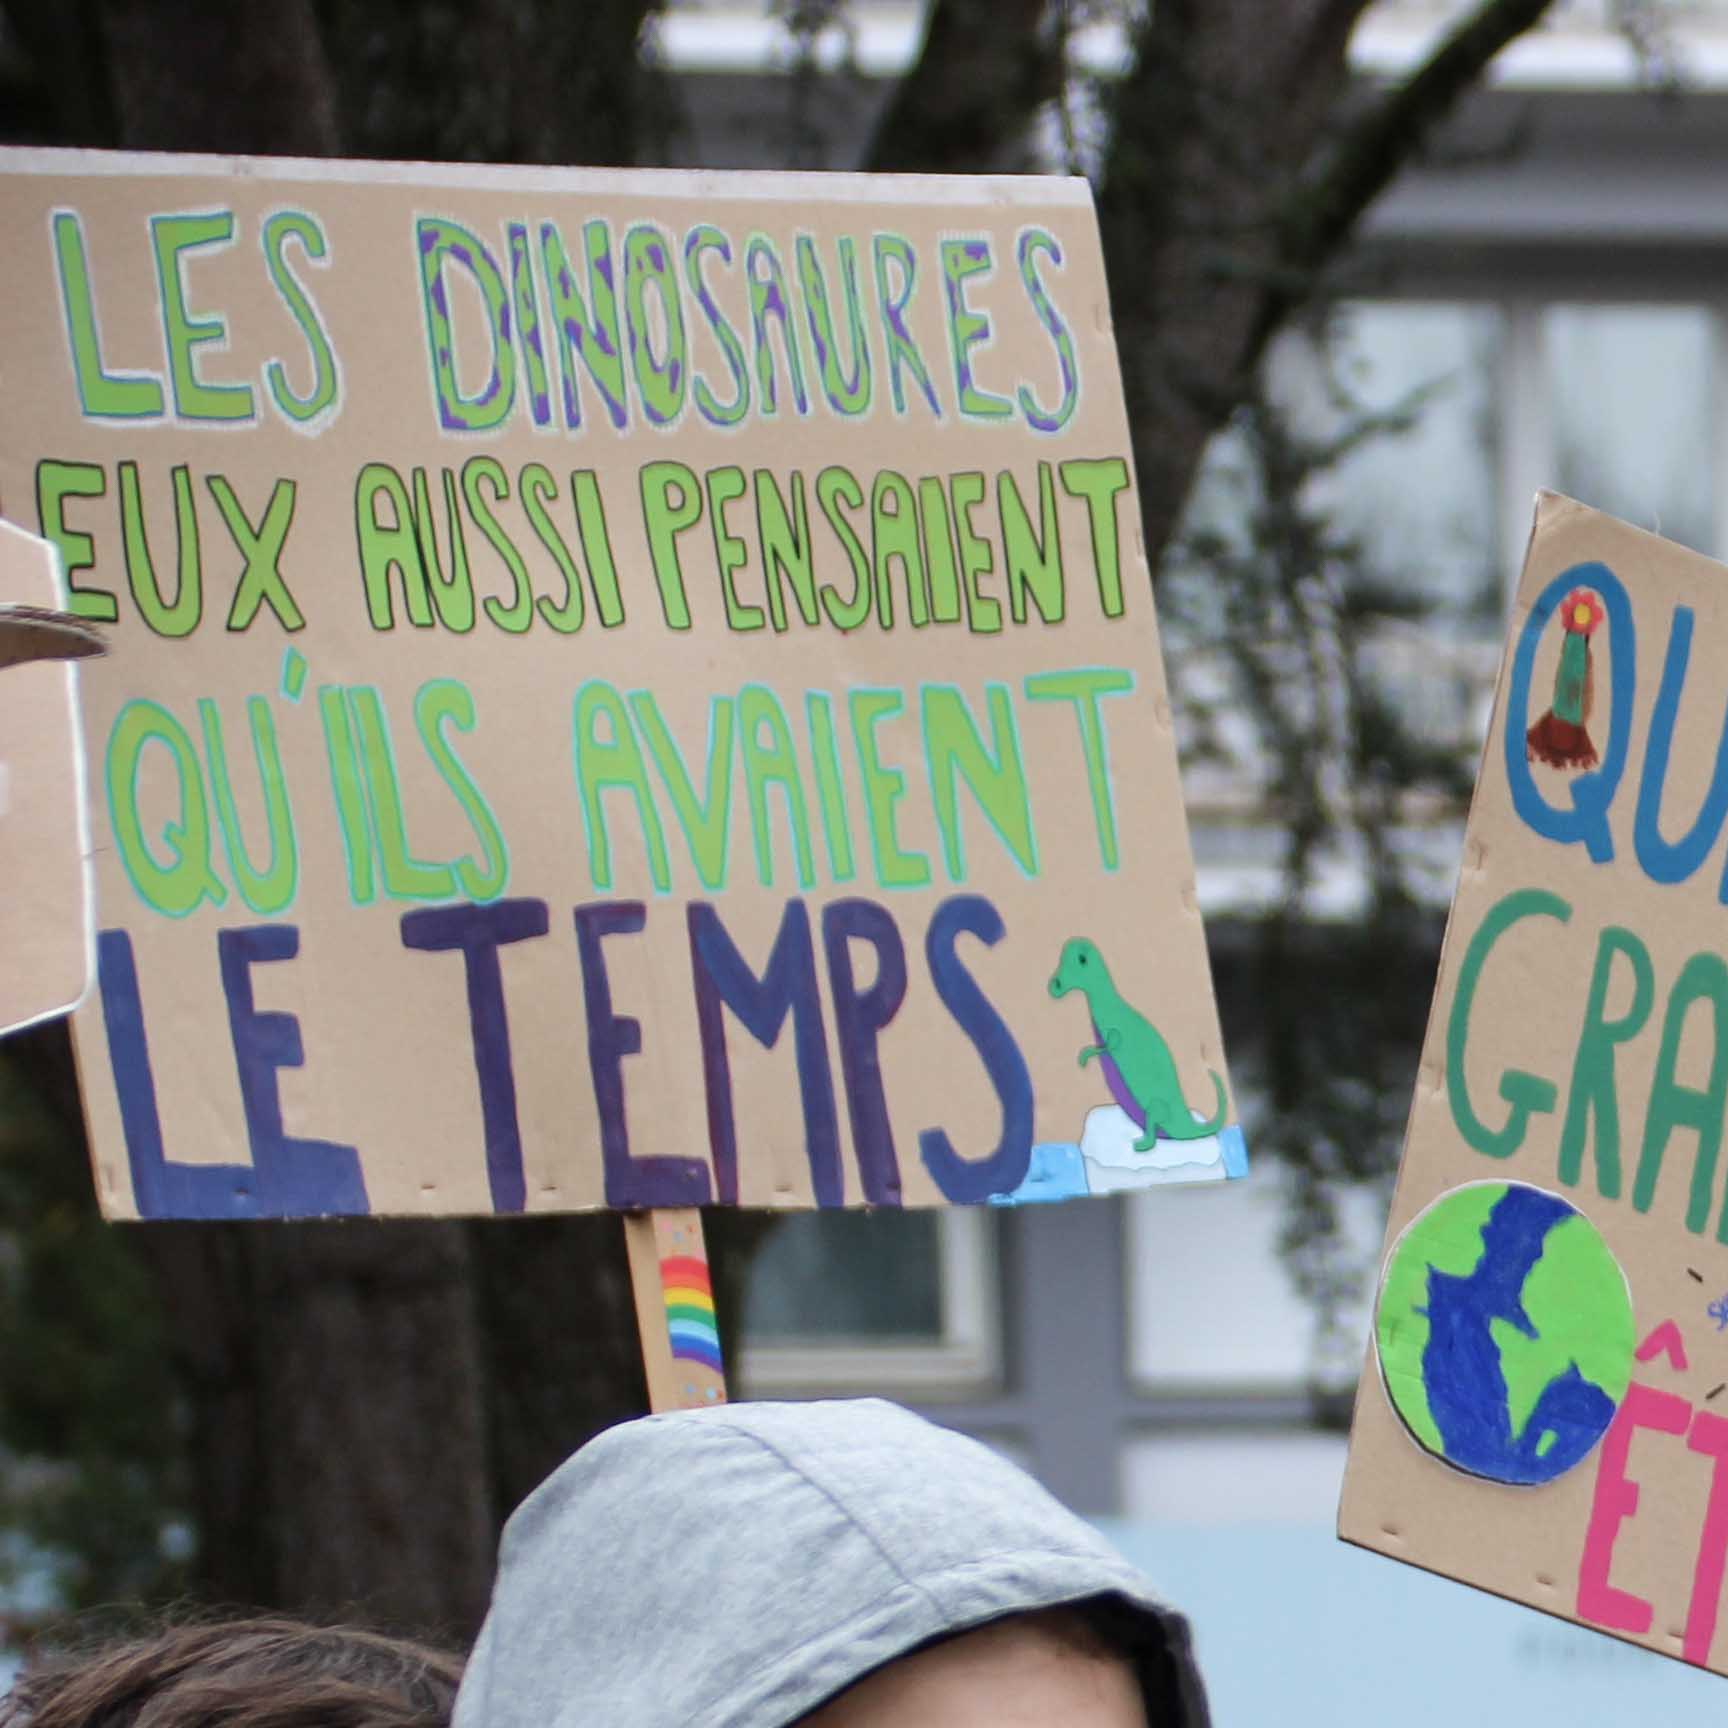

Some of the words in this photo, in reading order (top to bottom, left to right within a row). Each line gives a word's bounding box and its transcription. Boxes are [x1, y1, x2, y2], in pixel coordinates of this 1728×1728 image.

[53, 210, 340, 423] LES
[415, 216, 1079, 435] DINOSAURES
[36, 458, 306, 637] EUX
[354, 456, 625, 635] AUSSI
[639, 456, 1131, 635] PENSAIENT
[104, 645, 509, 919] QU'ILS
[572, 665, 1136, 898] AVAIENT
[98, 923, 371, 1221] LE
[399, 893, 1037, 1217] TEMPS
